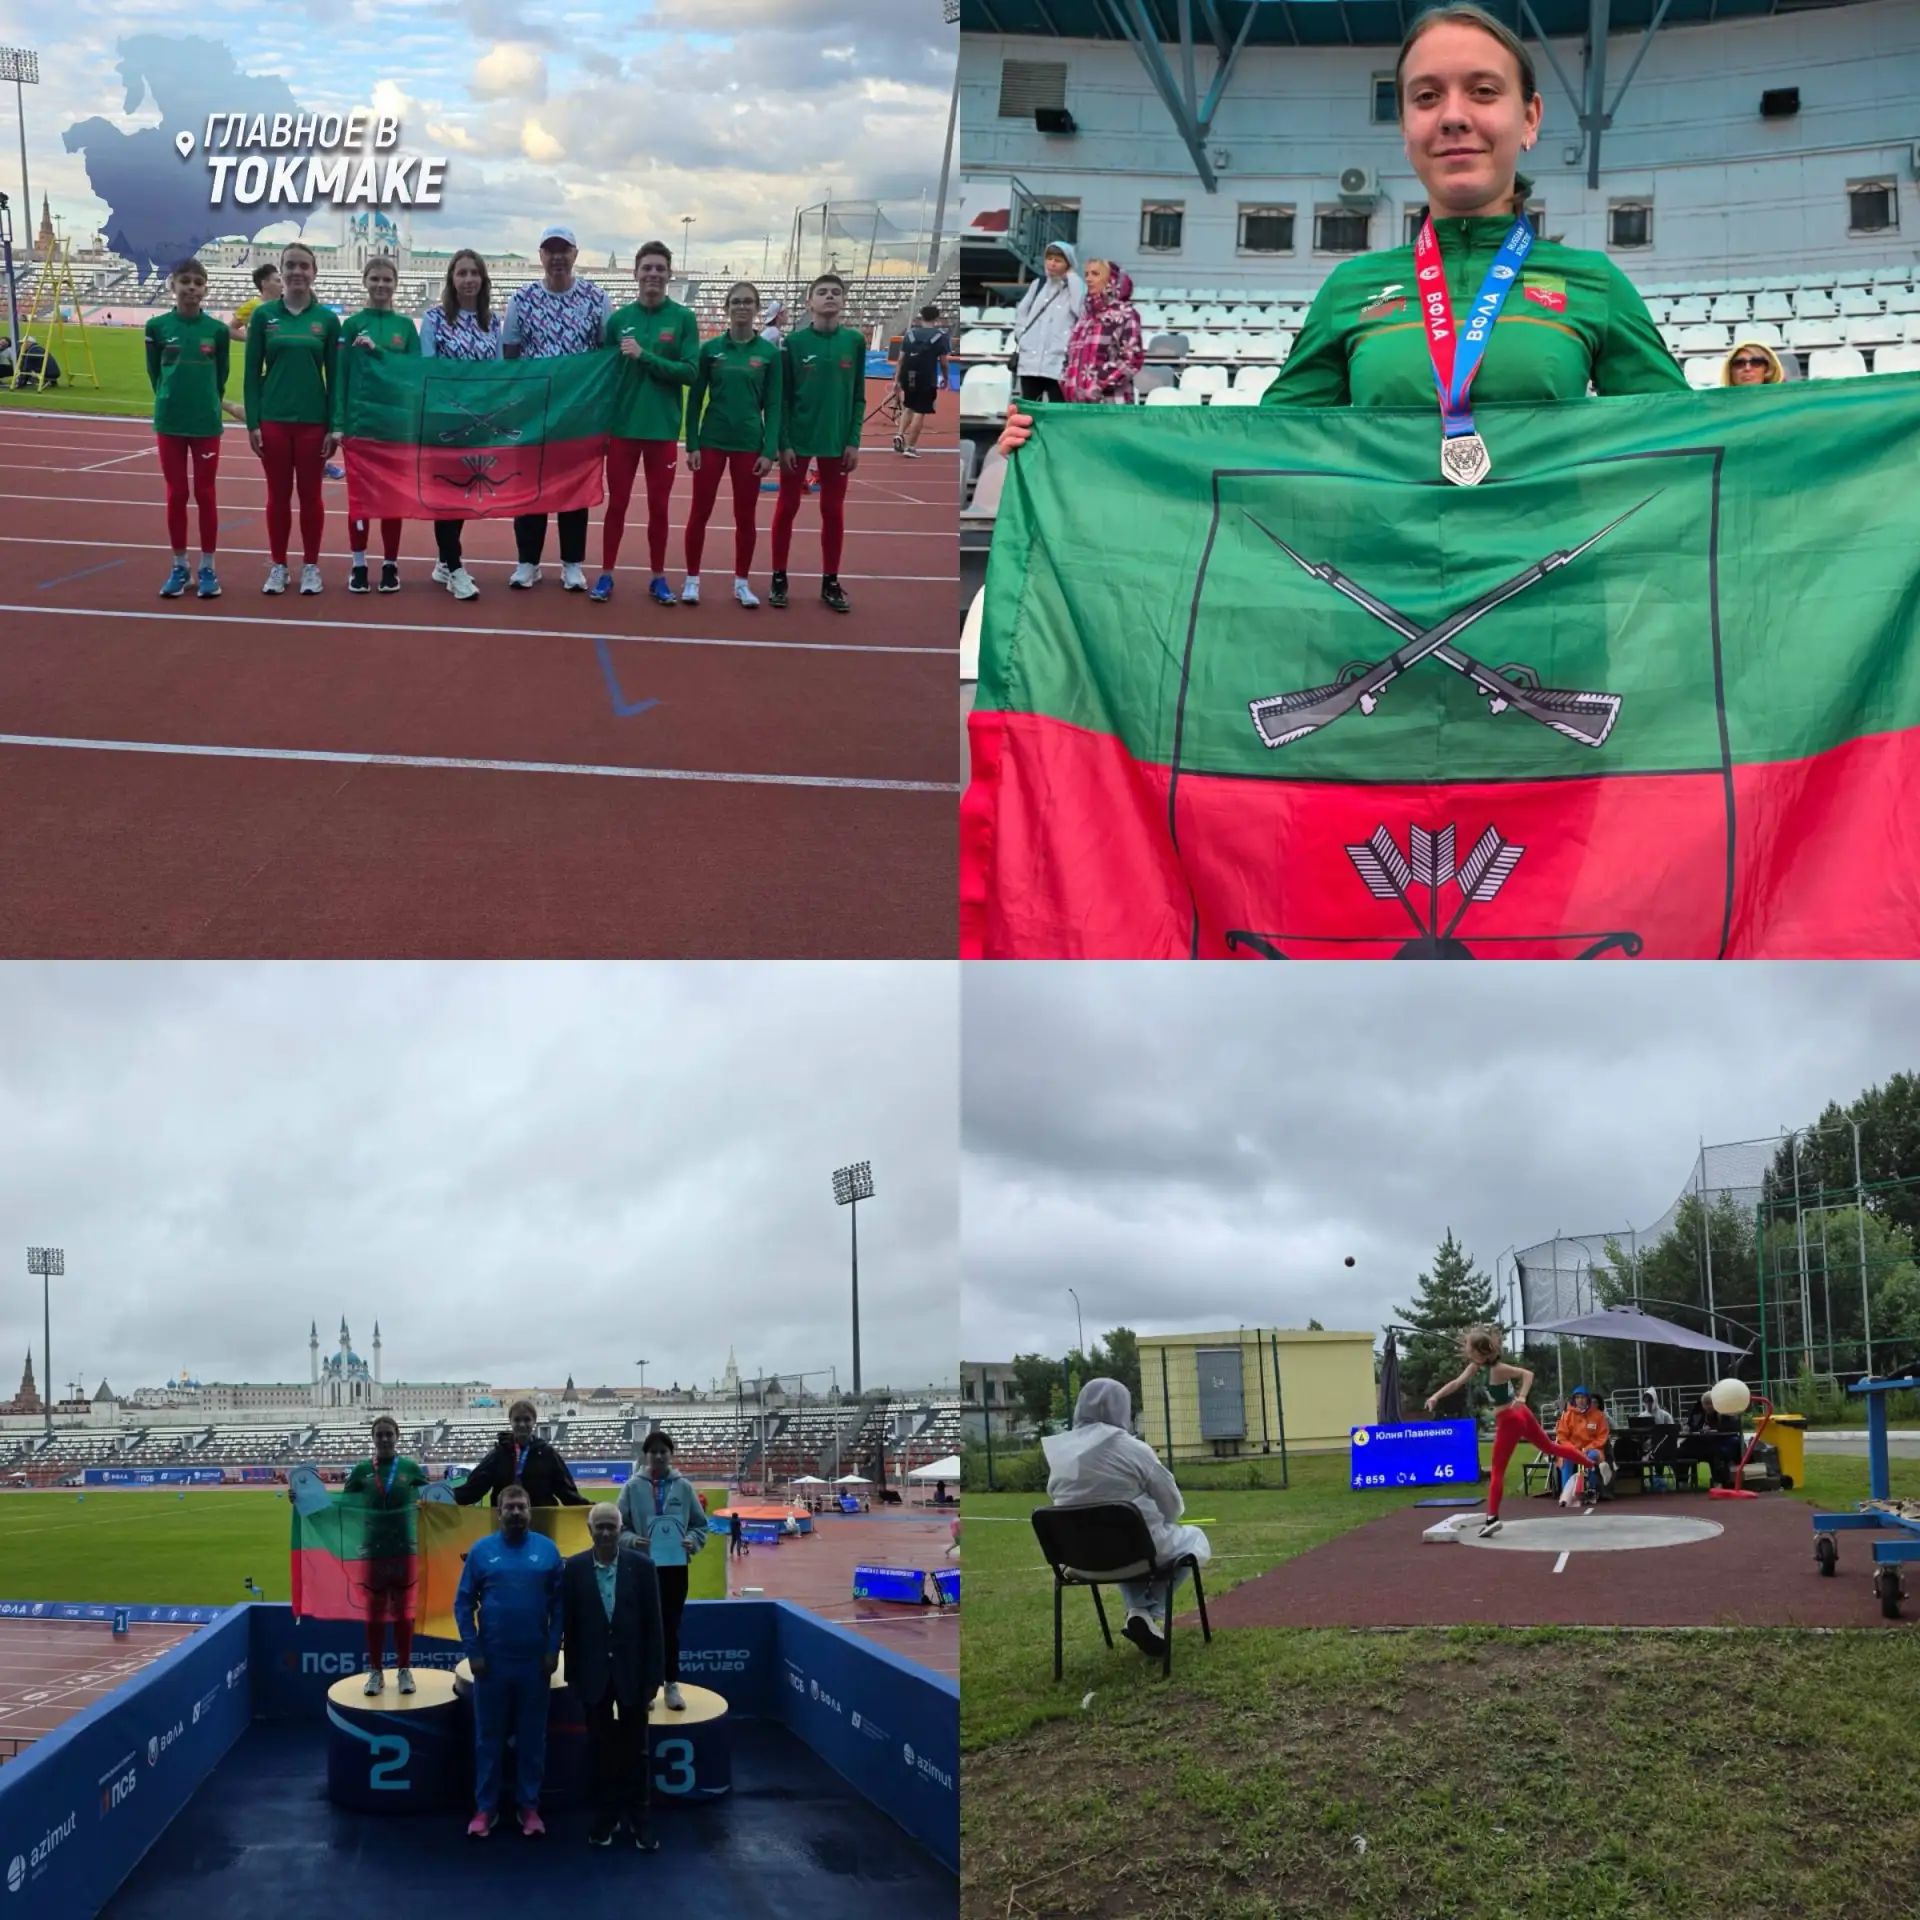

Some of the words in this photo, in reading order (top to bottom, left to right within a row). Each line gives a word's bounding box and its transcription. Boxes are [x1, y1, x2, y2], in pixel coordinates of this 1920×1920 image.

[1426, 291, 1449, 341] ВФЛА
[1465, 292, 1500, 341] ВФЛА
[1375, 1431, 1403, 1440] Юлия
[1404, 1428, 1453, 1439] Павленко
[1365, 1475, 1385, 1484] 859
[1409, 1473, 1417, 1481] 4
[1434, 1465, 1454, 1477] 46
[116, 1615, 125, 1631] 1
[302, 1653, 355, 1674] ПСБ
[820, 1690, 842, 1714] ВФЛА
[160, 1720, 184, 1751] ВФЛА
[370, 1735, 411, 1789] 2
[655, 1739, 696, 1793] 3
[917, 1755, 953, 1791] azimut
[111, 1768, 136, 1808] ПСБ
[31, 1810, 77, 1867] azimut
